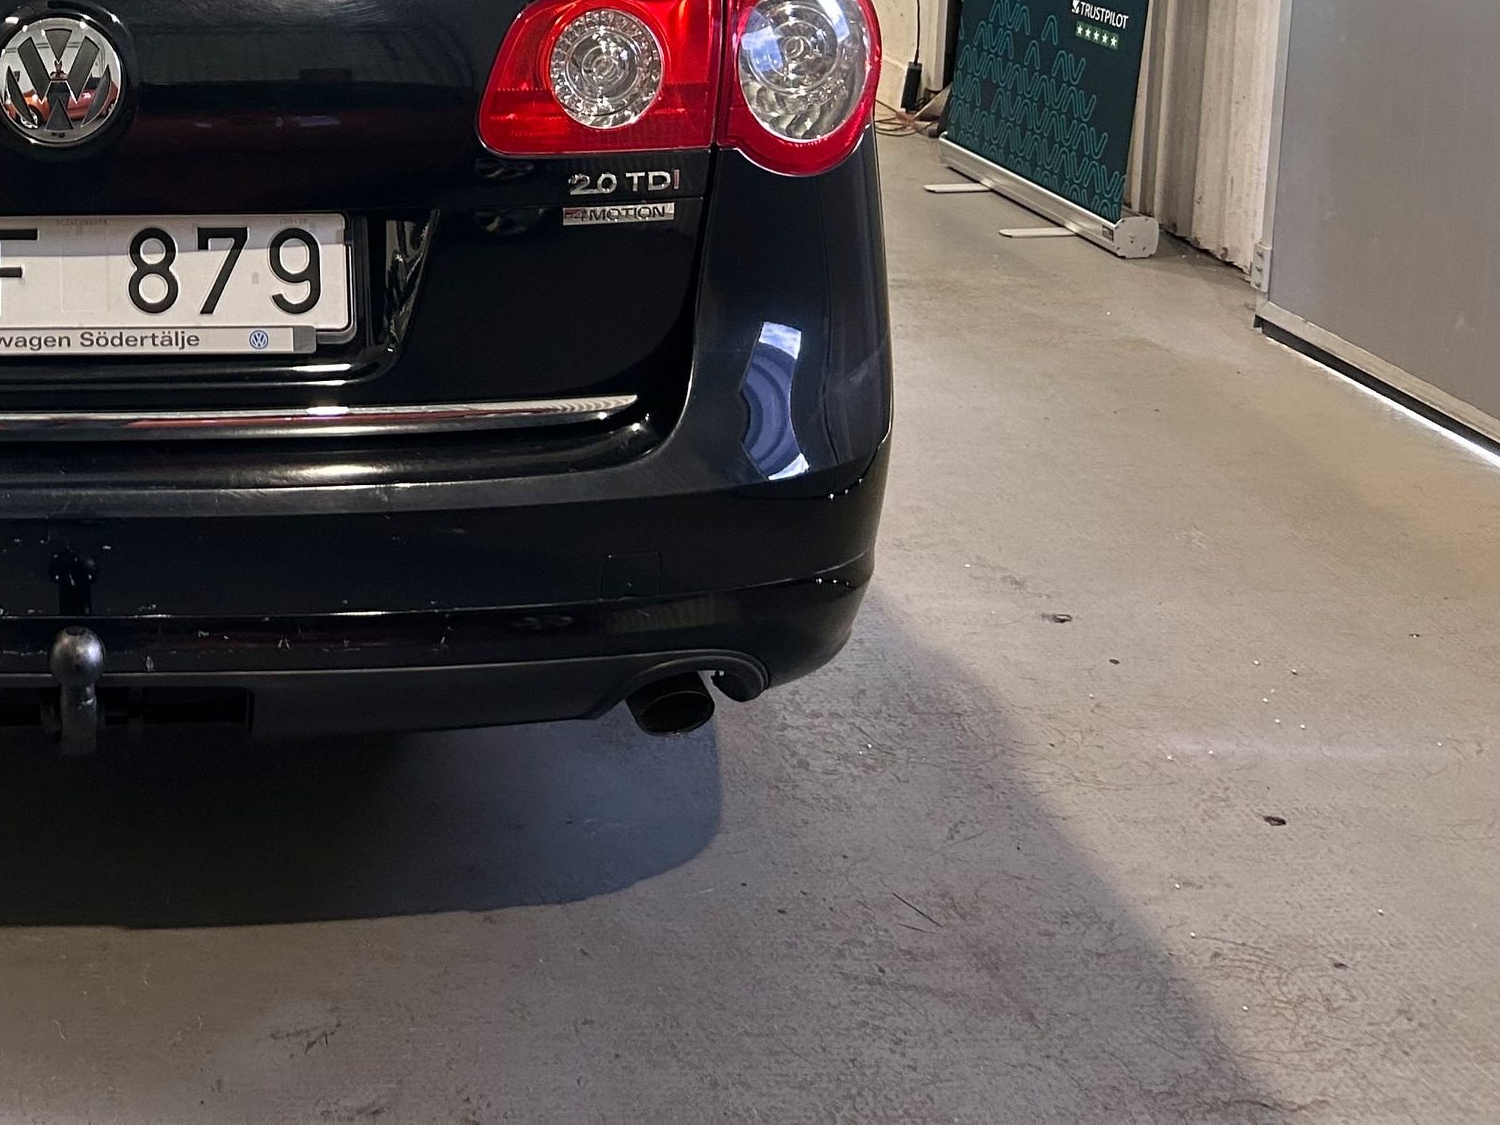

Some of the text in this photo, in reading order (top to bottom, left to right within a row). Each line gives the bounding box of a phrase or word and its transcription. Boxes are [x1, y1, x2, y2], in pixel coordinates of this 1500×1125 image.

[1080, 1, 1129, 29] TRUSTPILOT
[625, 169, 681, 192] TDI
[566, 205, 667, 224] 4MOTION
[128, 227, 322, 315] 879
[80, 330, 200, 350] Södertälje
